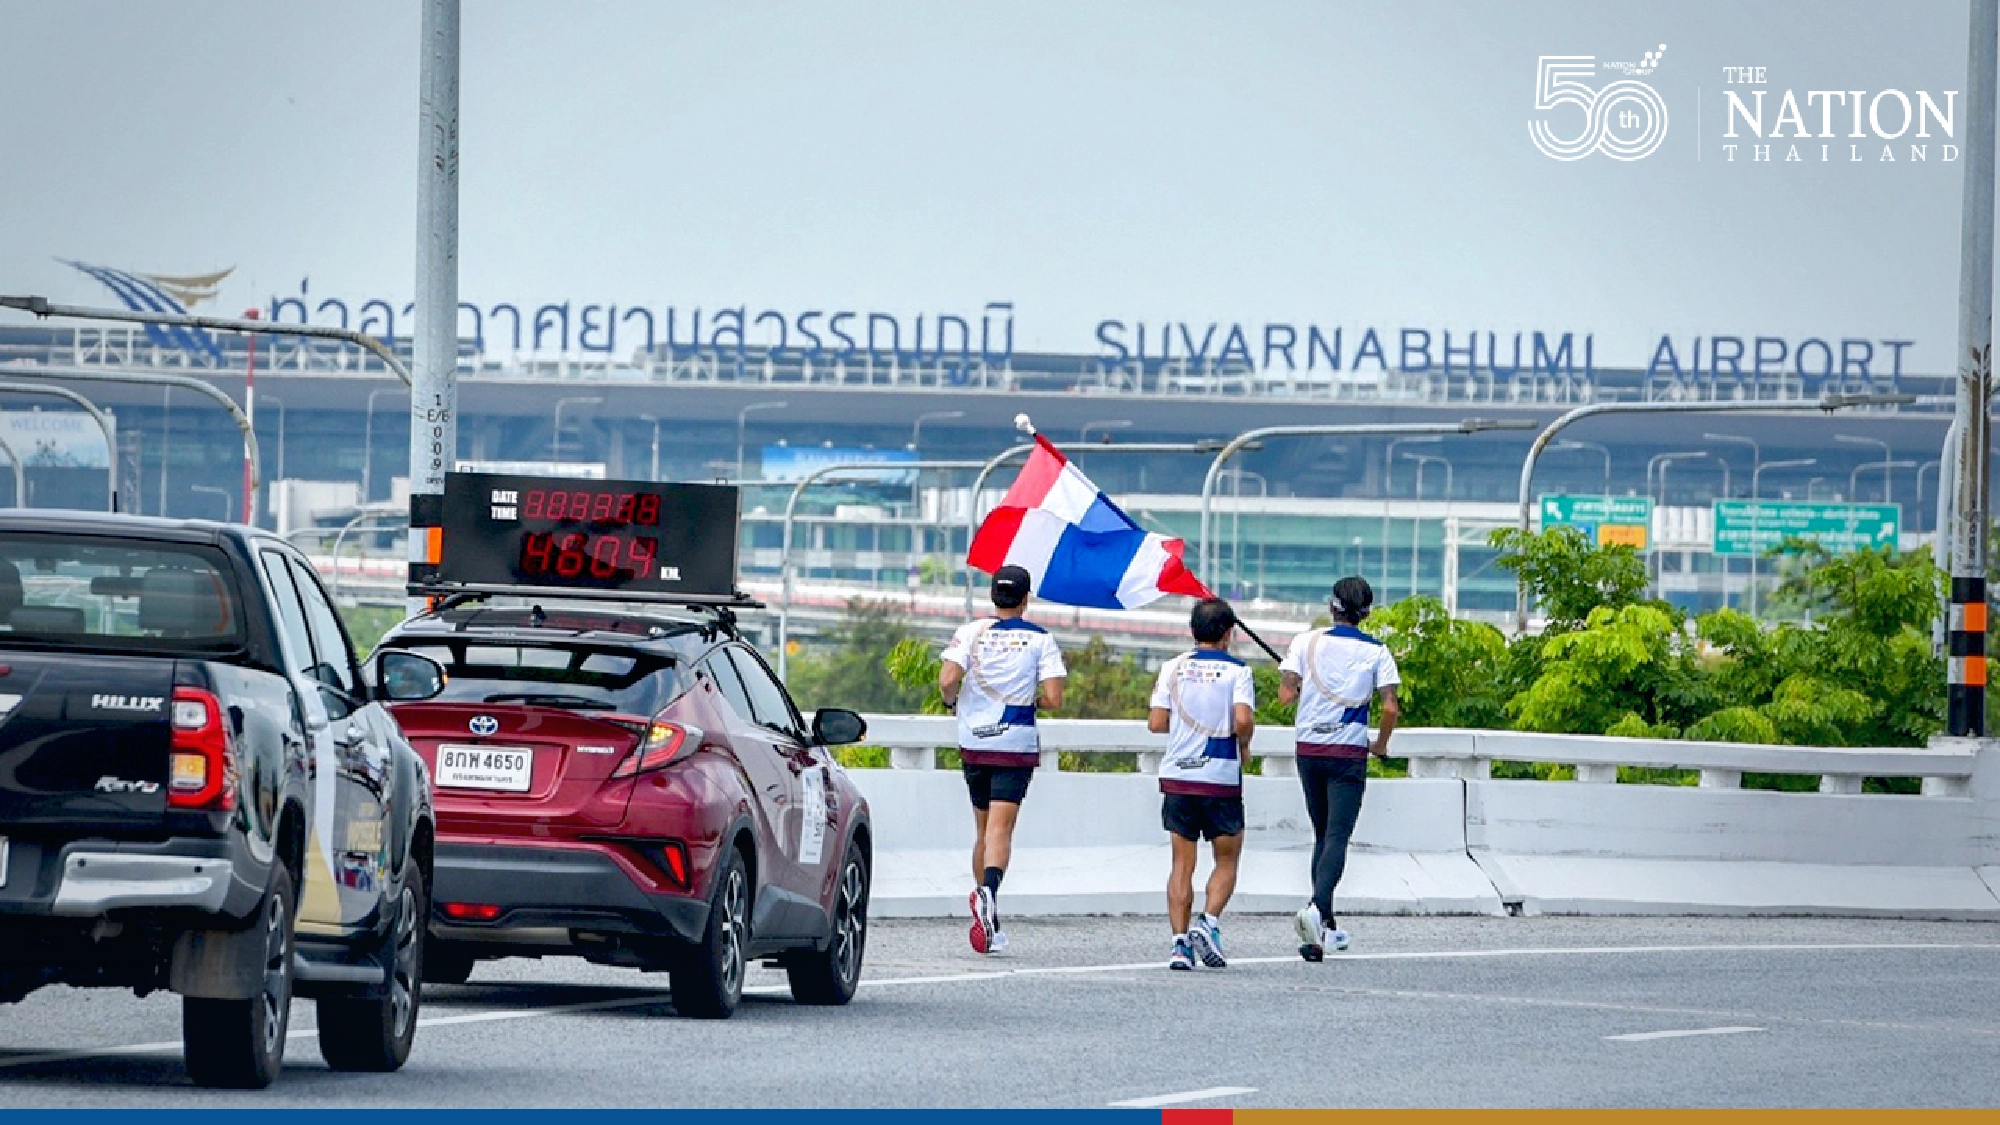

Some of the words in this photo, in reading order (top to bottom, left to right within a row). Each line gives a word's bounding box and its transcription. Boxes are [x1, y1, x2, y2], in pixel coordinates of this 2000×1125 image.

[1095, 319, 1594, 381] SUVARNABHUMI
[1647, 333, 1916, 386] AIRPORT
[491, 489, 518, 504] DATE
[491, 505, 518, 520] TIME
[525, 533, 658, 578] 4604
[91, 694, 164, 712] HILUX
[483, 752, 524, 771] 4650
